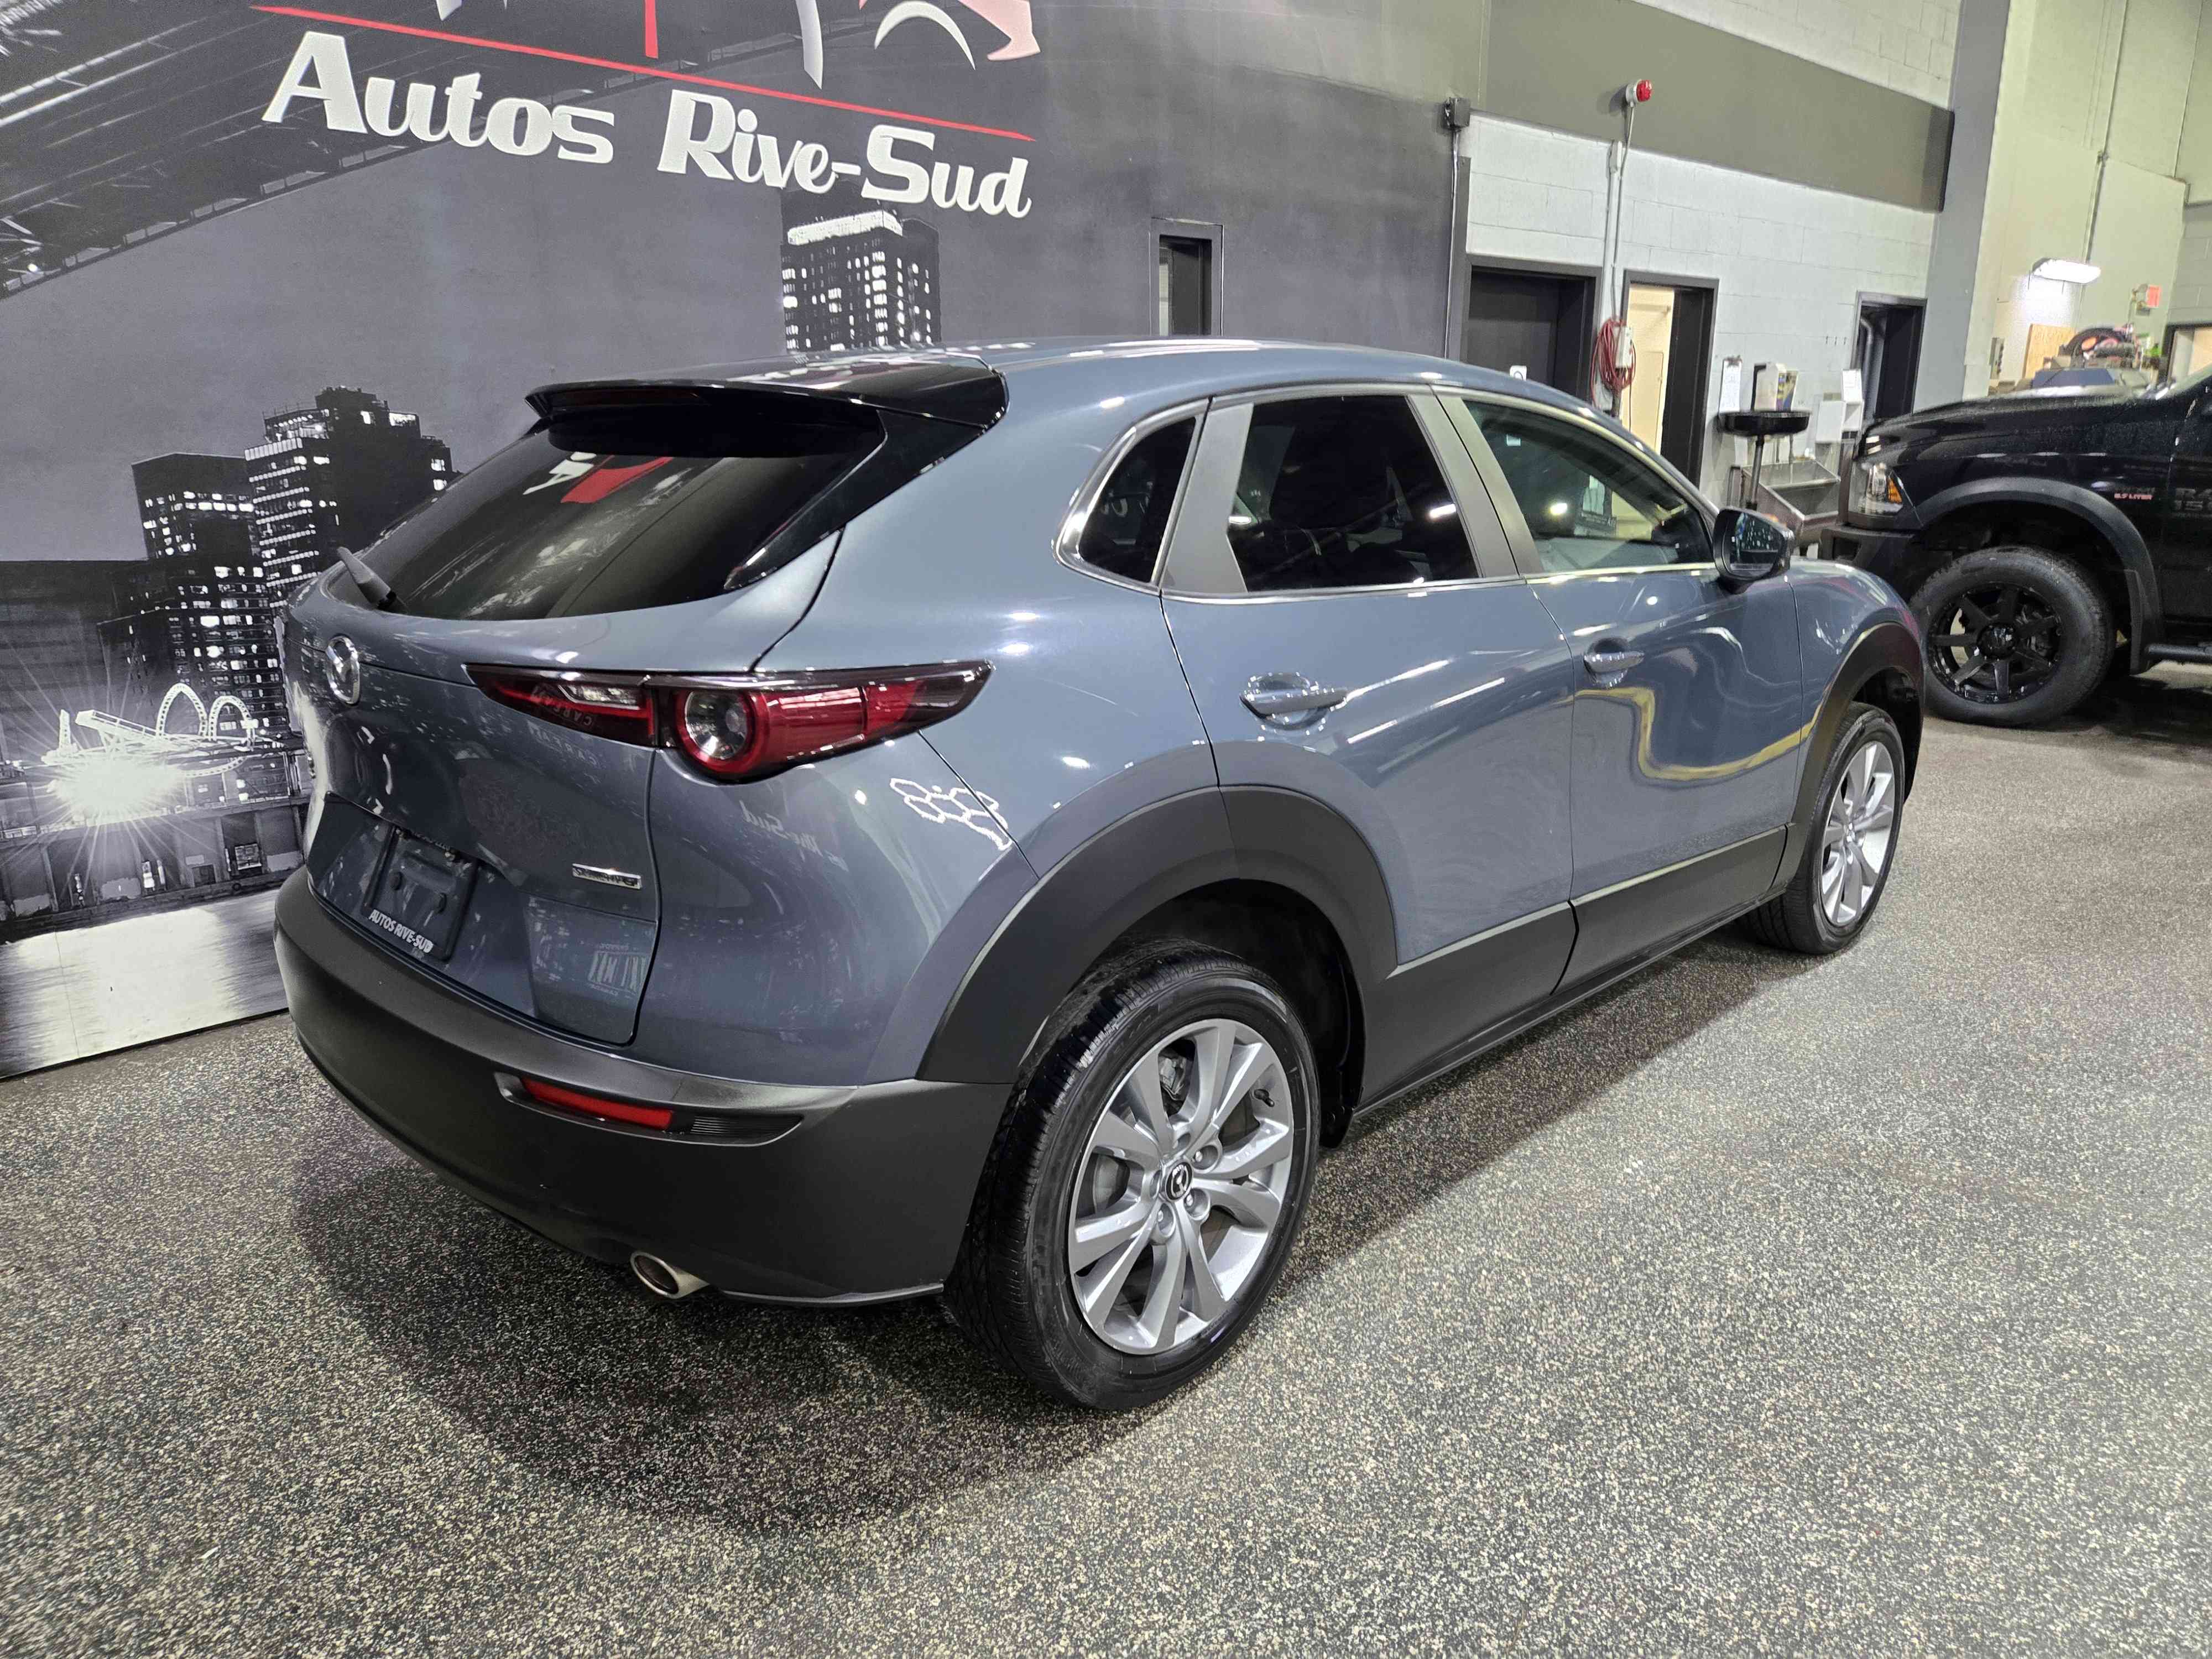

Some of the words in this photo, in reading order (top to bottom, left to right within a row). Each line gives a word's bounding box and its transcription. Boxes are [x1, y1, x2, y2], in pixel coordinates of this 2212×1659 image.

[262, 31, 614, 164] Autos
[657, 89, 1032, 219] Rive-Sud
[368, 909, 397, 932] AUTOS
[394, 924, 434, 953] RIVE-SUD
